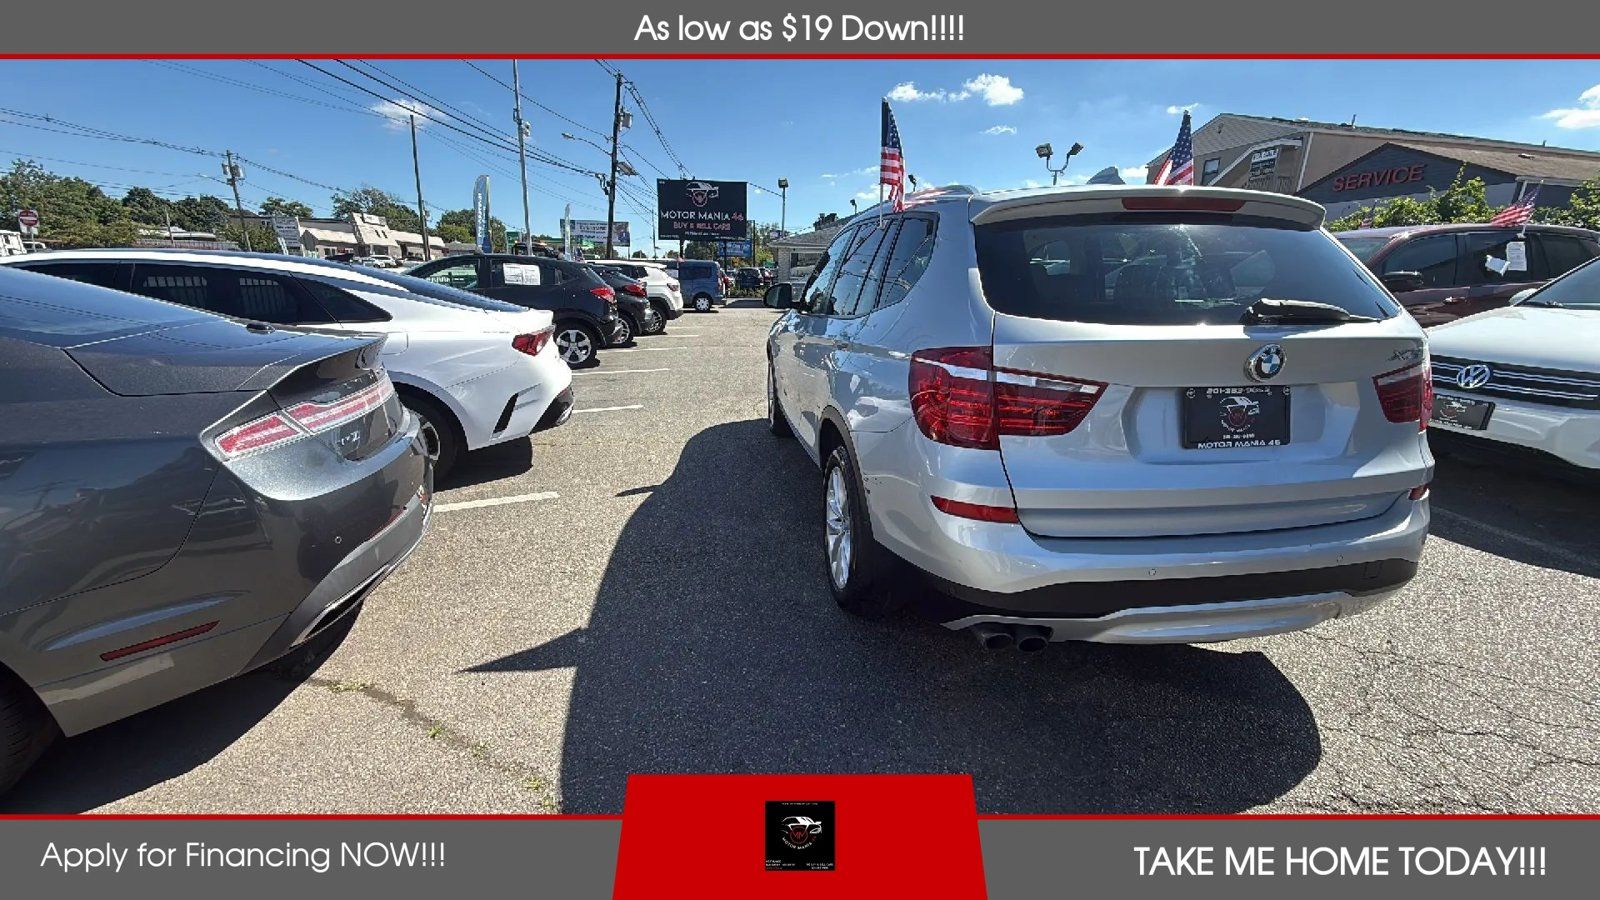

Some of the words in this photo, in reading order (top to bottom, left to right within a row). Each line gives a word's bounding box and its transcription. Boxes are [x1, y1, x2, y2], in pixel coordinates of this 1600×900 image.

[1333, 165, 1424, 192] SERVICE
[660, 210, 695, 219] MOTOR
[699, 211, 731, 220] MANIA
[1198, 441, 1232, 449] MOTOR
[1235, 440, 1266, 448] MANIA
